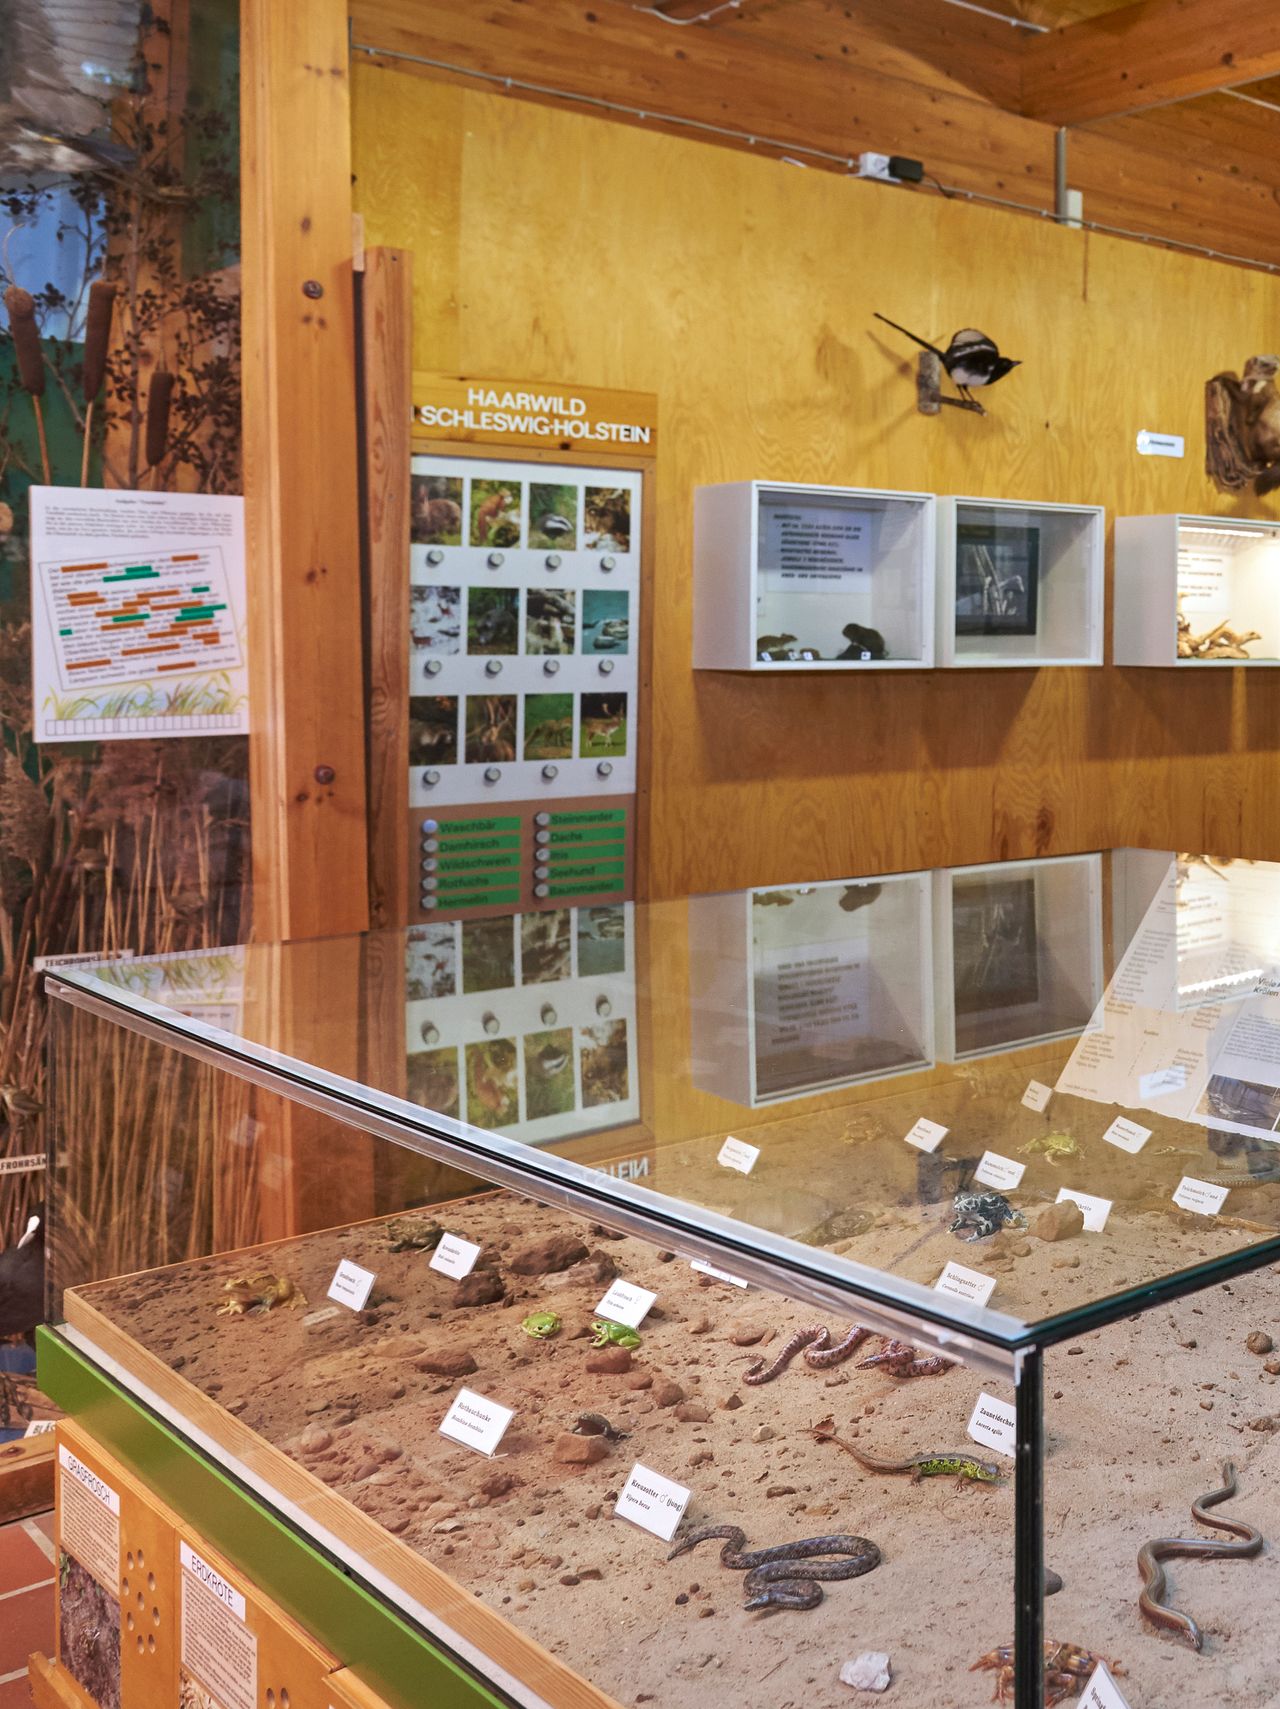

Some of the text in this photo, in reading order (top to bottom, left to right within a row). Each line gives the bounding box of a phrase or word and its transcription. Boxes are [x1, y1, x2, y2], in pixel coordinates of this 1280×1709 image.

[468, 388, 586, 416] HAARWILD
[420, 405, 650, 444] SCHLESWIG-HOLSTEIN
[551, 831, 583, 843] Dachs
[439, 856, 512, 870] Wildschwein
[550, 866, 596, 880] Seehund
[0, 1156, 48, 1171] FROHRSÄN
[975, 1419, 992, 1431] Lacerta
[979, 1407, 1015, 1428] Zauneidechse
[68, 1455, 110, 1504] GRASFROSCH
[631, 1479, 683, 1512] Kreuzotter (jung)
[191, 1554, 234, 1608] ERDKRÖTE
